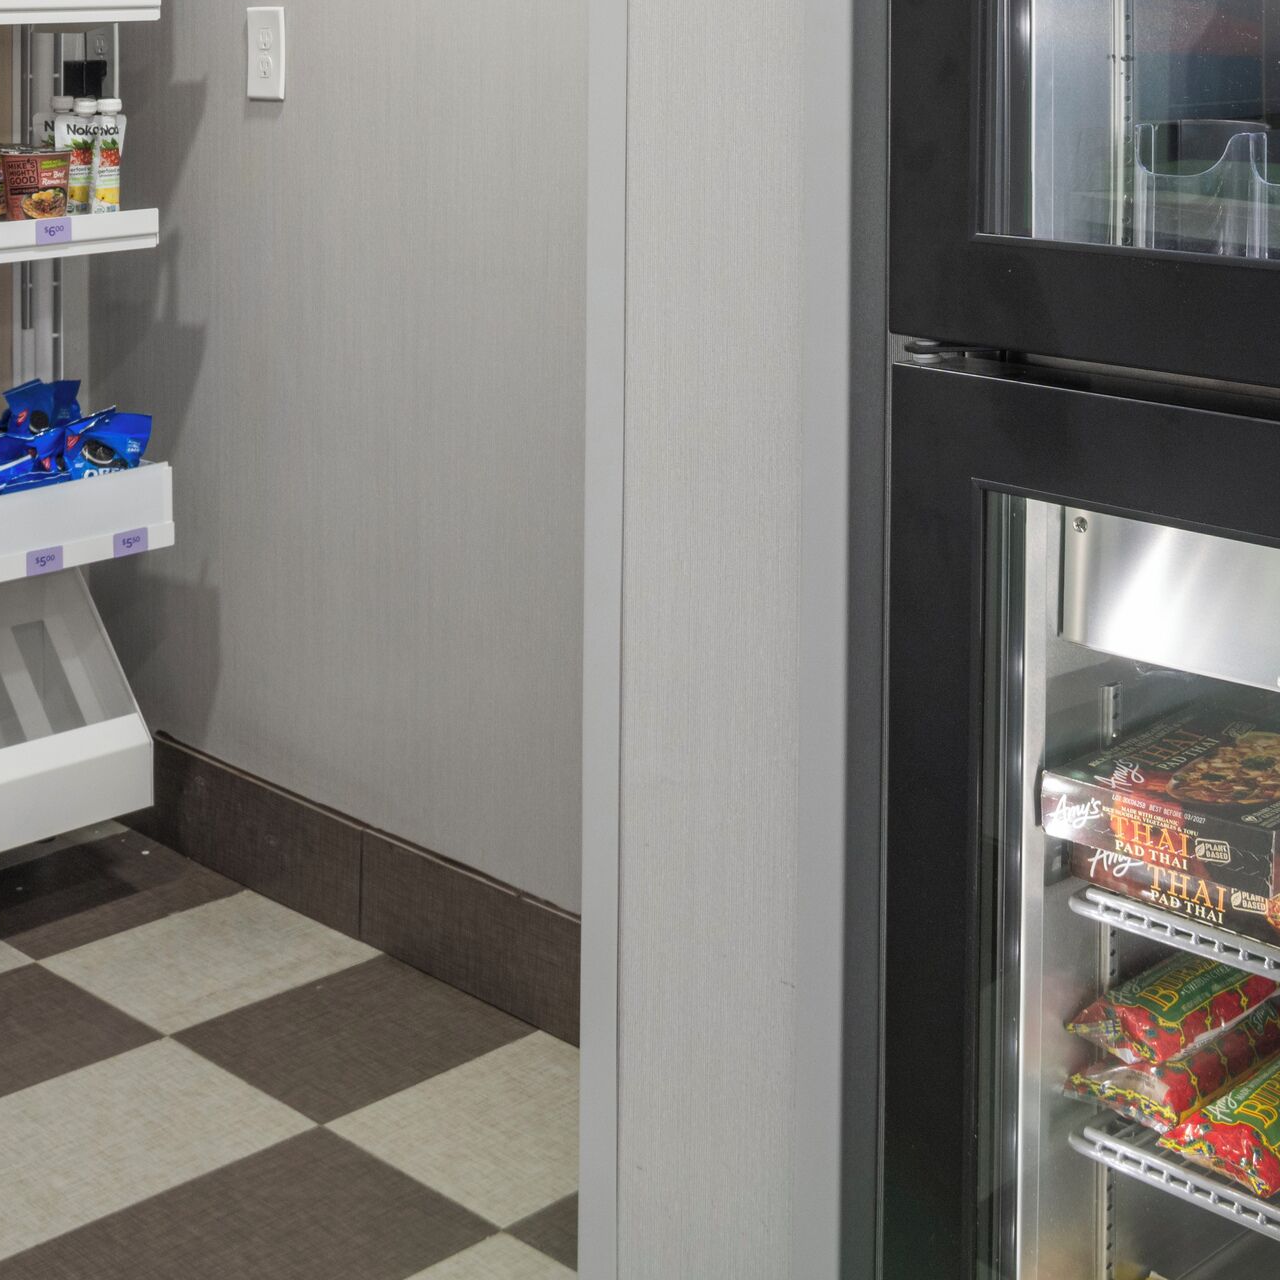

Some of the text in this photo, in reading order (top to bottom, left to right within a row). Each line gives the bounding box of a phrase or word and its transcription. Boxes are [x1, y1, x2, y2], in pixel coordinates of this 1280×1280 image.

[8, 160, 37, 171] MIKE'S
[8, 169, 37, 179] MIGHTY
[9, 176, 37, 186] GOOD
[1047, 793, 1105, 829] Amy's
[1110, 814, 1190, 859] THAI
[1205, 842, 1227, 852] PLANT
[1115, 839, 1188, 871] PAD THAI
[1206, 851, 1229, 861] BASED
[1147, 863, 1230, 913] THAI
[1150, 889, 1224, 925] PAD THAI
[1242, 900, 1266, 911] BASED
